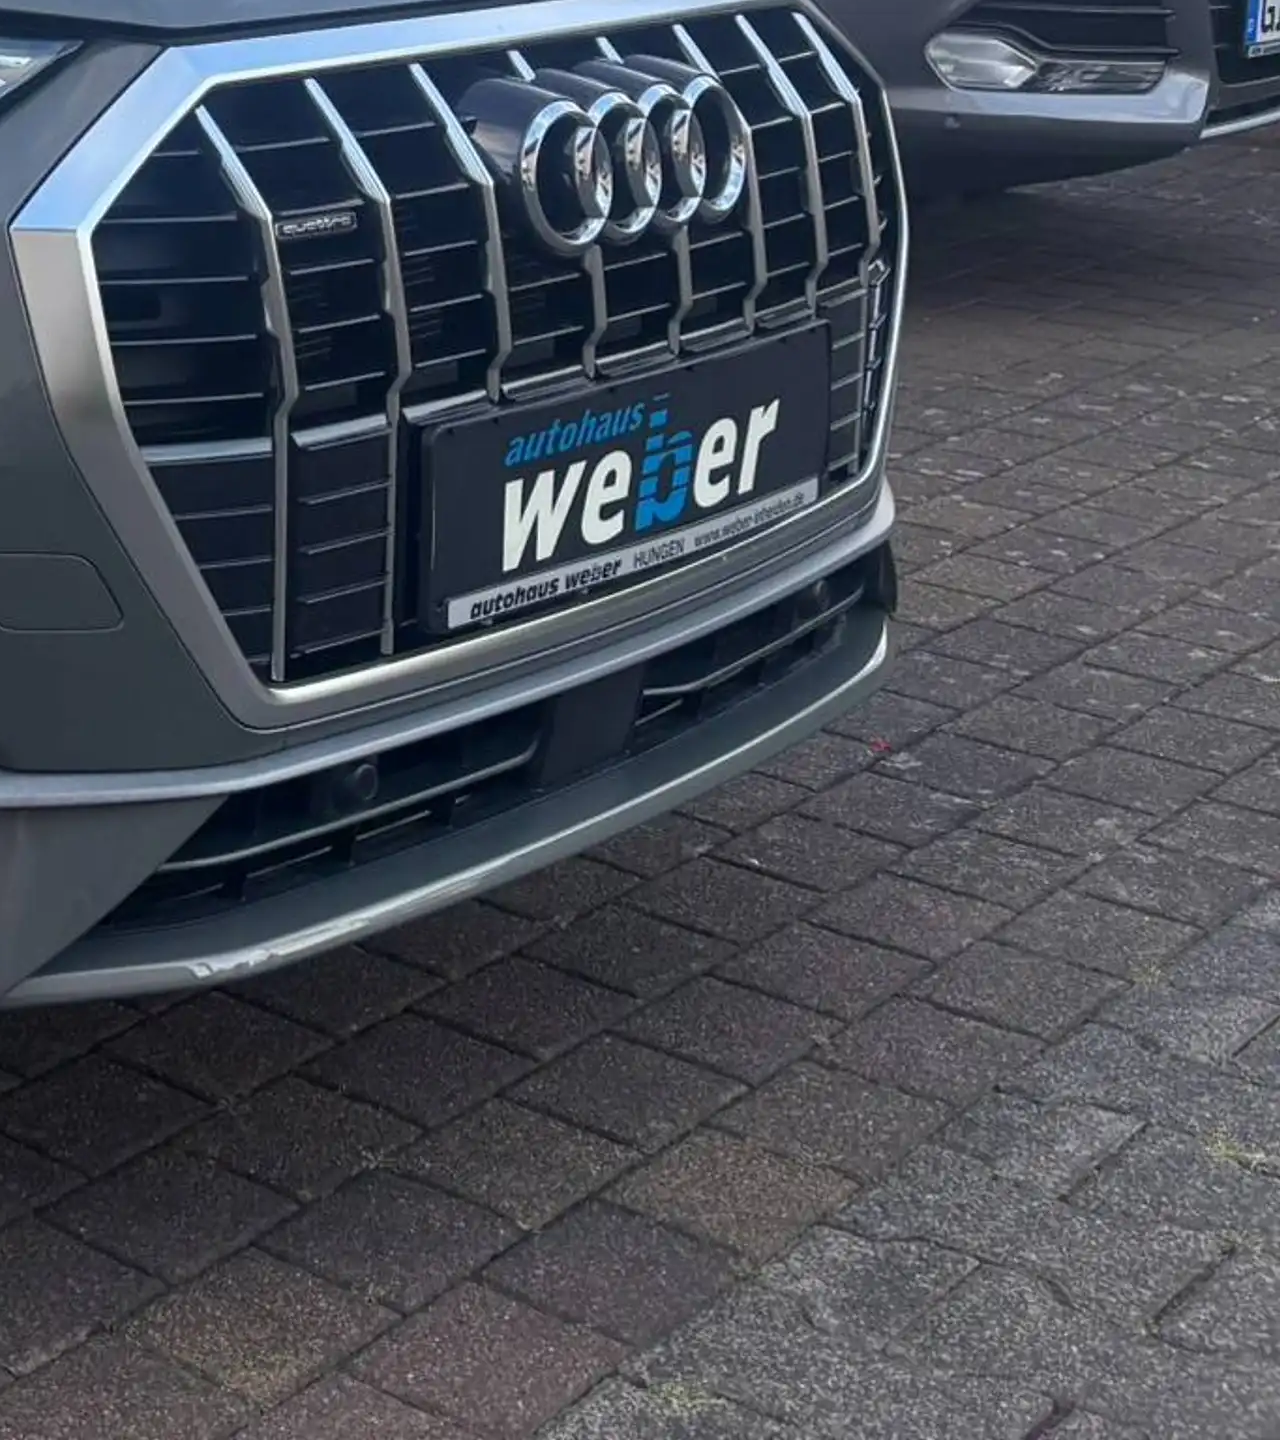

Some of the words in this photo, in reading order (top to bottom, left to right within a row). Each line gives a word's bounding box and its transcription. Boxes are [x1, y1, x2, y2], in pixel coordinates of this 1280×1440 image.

[504, 401, 646, 467] autohaus
[502, 393, 781, 572] weber
[469, 576, 560, 620] autohaus
[565, 558, 622, 590] weber
[633, 536, 686, 569] HUNGEN
